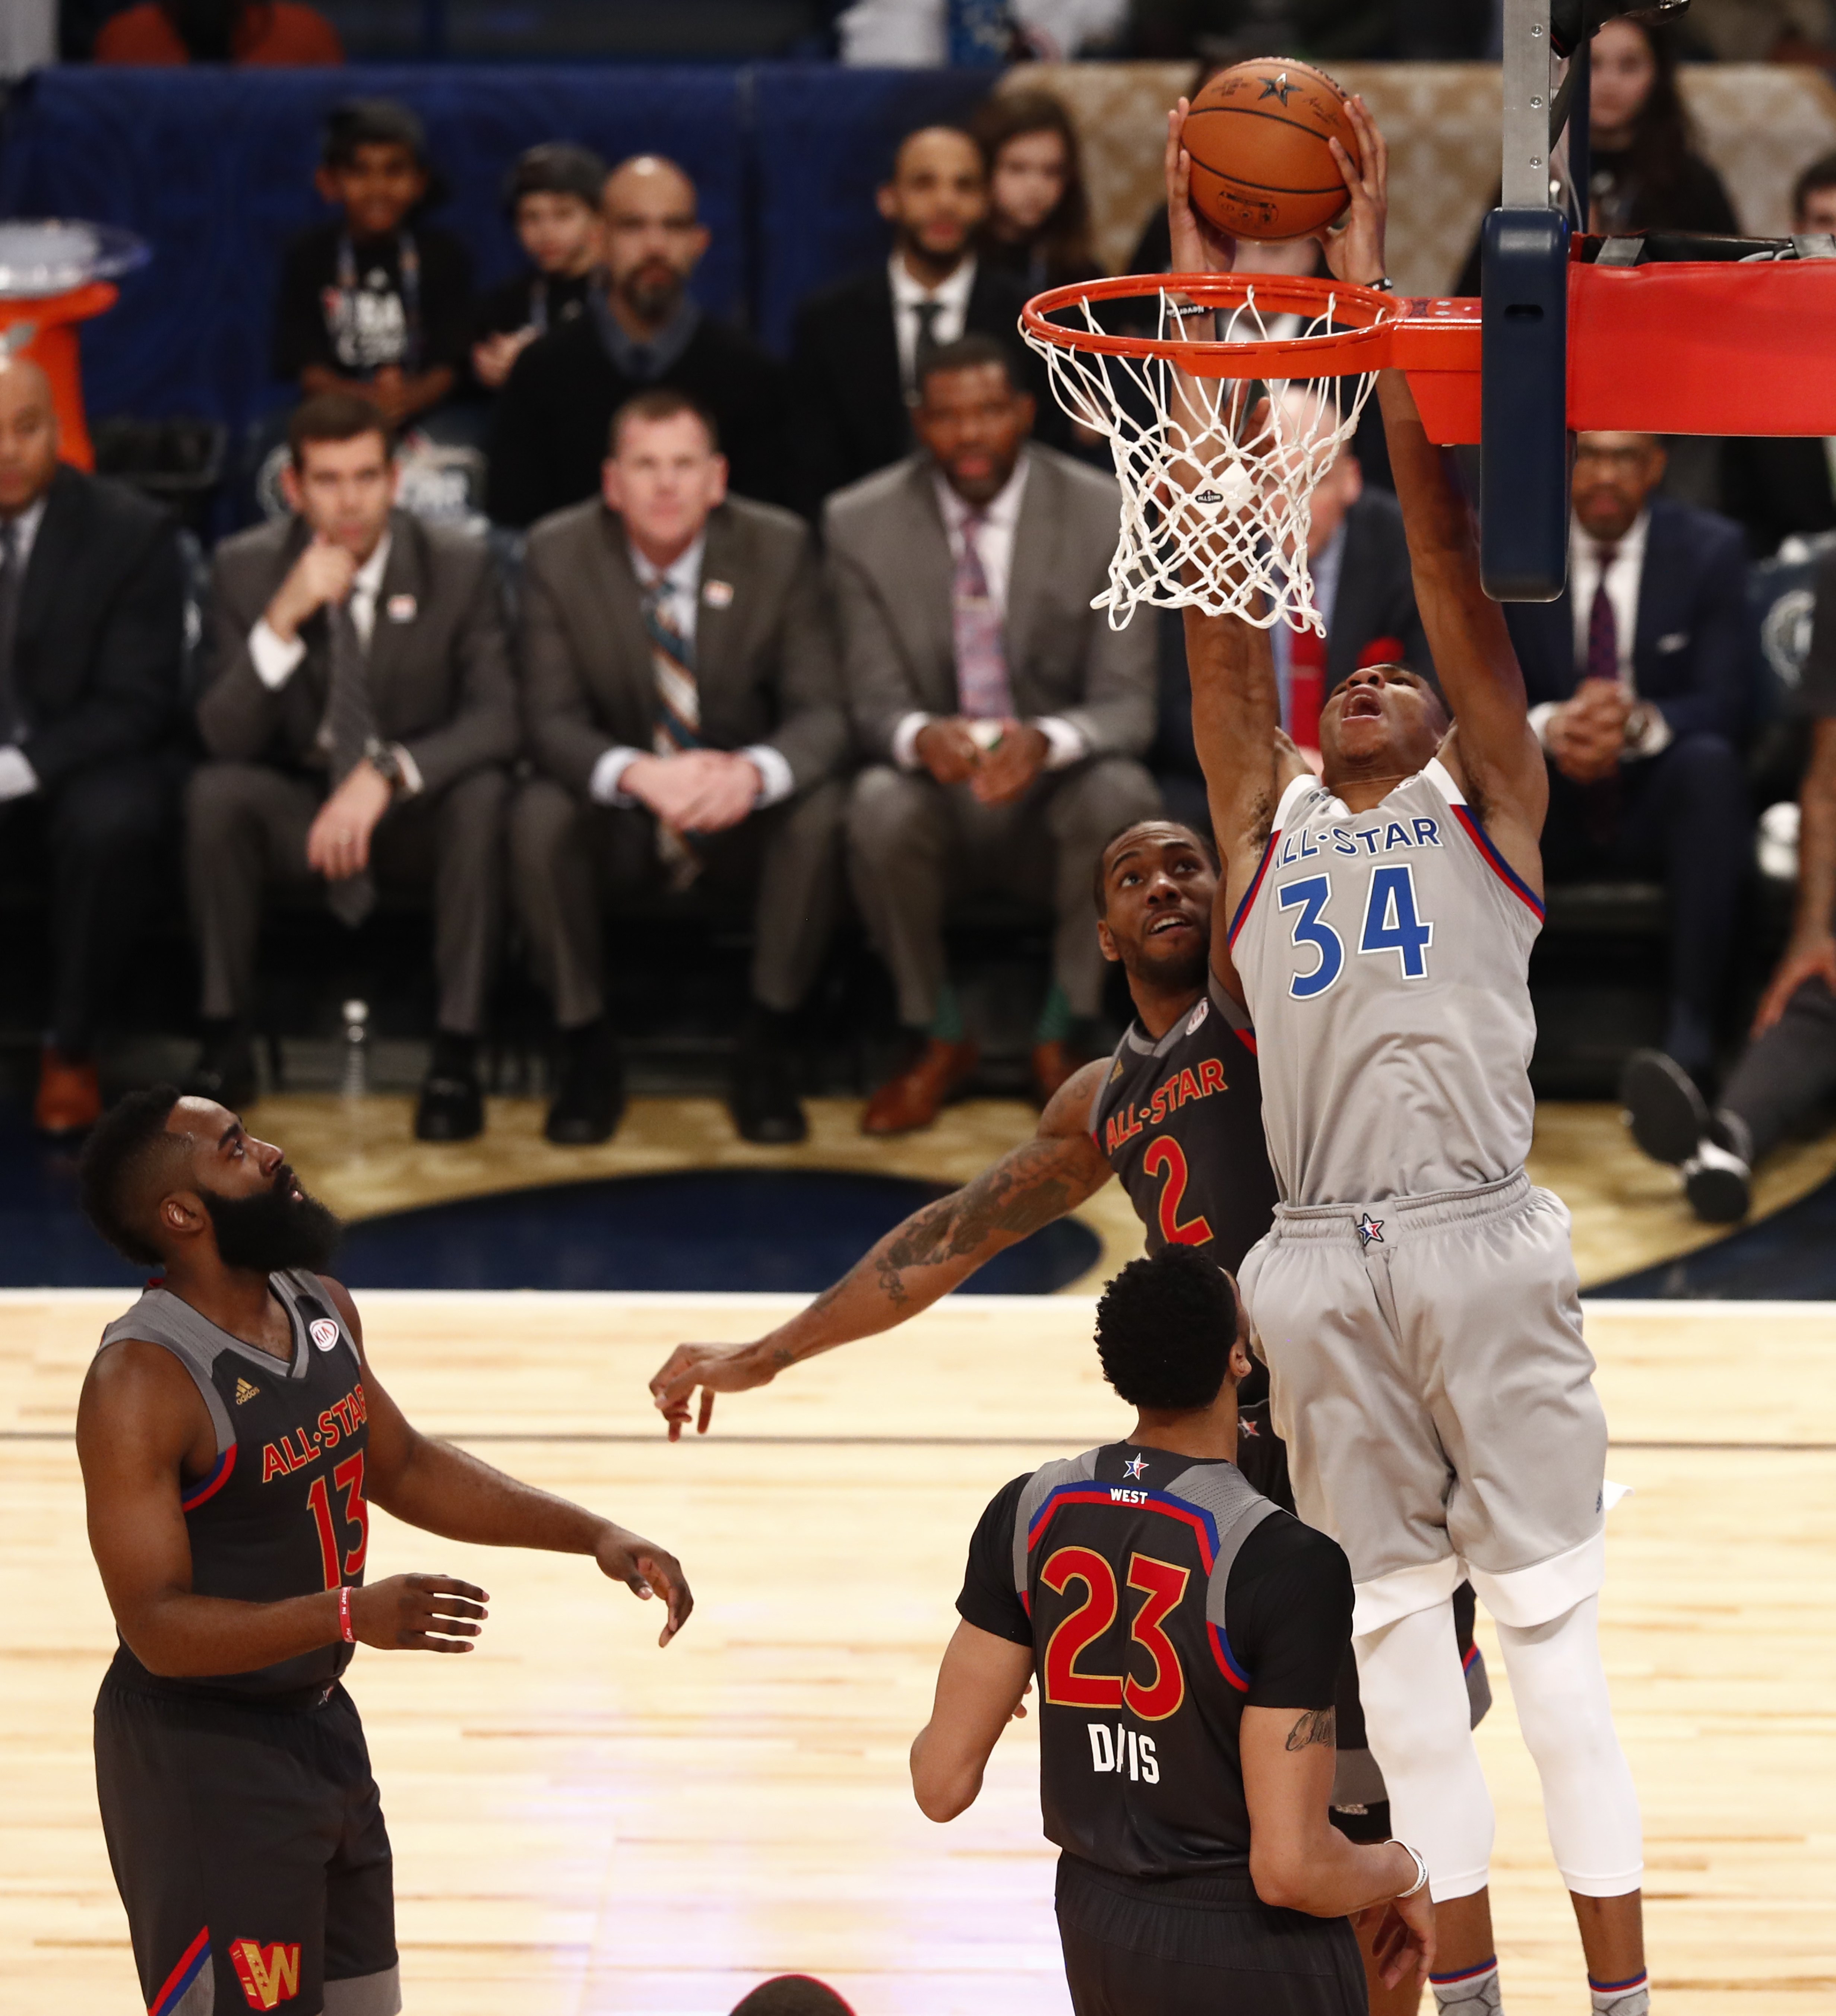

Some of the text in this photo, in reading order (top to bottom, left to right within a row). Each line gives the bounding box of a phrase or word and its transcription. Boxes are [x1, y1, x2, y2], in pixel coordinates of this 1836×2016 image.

[1277, 863, 1434, 1000] 34
[1143, 1135, 1214, 1247] 2
[313, 1326, 333, 1345] KIA
[236, 1386, 260, 1405] adidas
[306, 1447, 369, 1590] 13
[1110, 1488, 1148, 1505] WEST
[1040, 1546, 1191, 1721] 23
